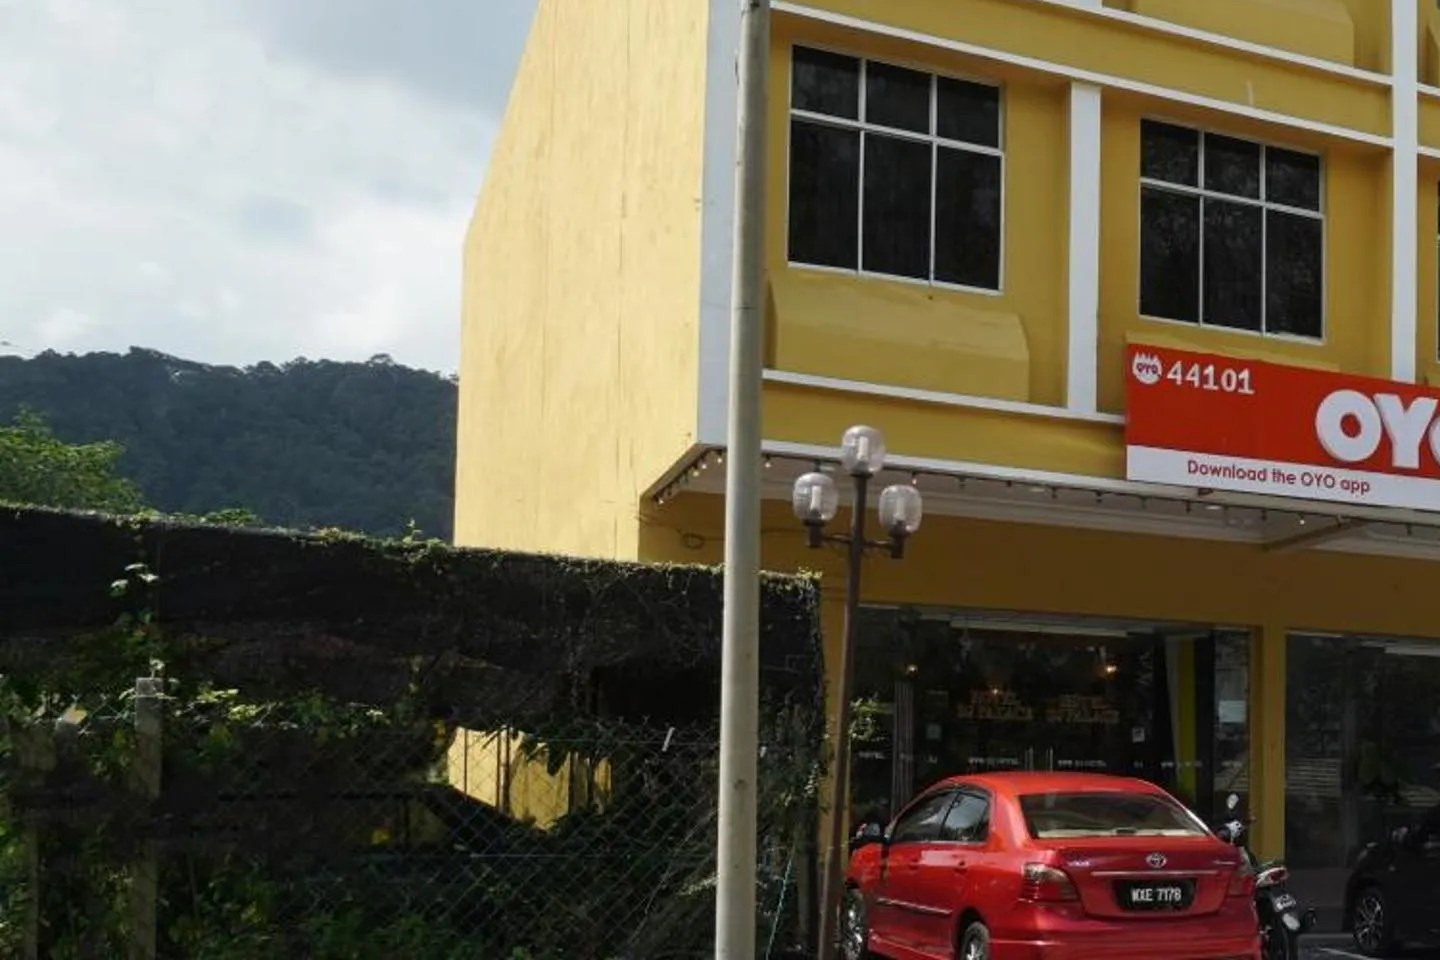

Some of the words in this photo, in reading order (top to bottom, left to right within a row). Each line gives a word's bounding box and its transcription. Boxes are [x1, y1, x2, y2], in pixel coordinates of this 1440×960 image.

[1167, 360, 1255, 395] 44101
[1187, 460, 1267, 482] Download
[1272, 468, 1296, 485] the
[1300, 471, 1336, 490] OYO
[1339, 478, 1371, 495] app
